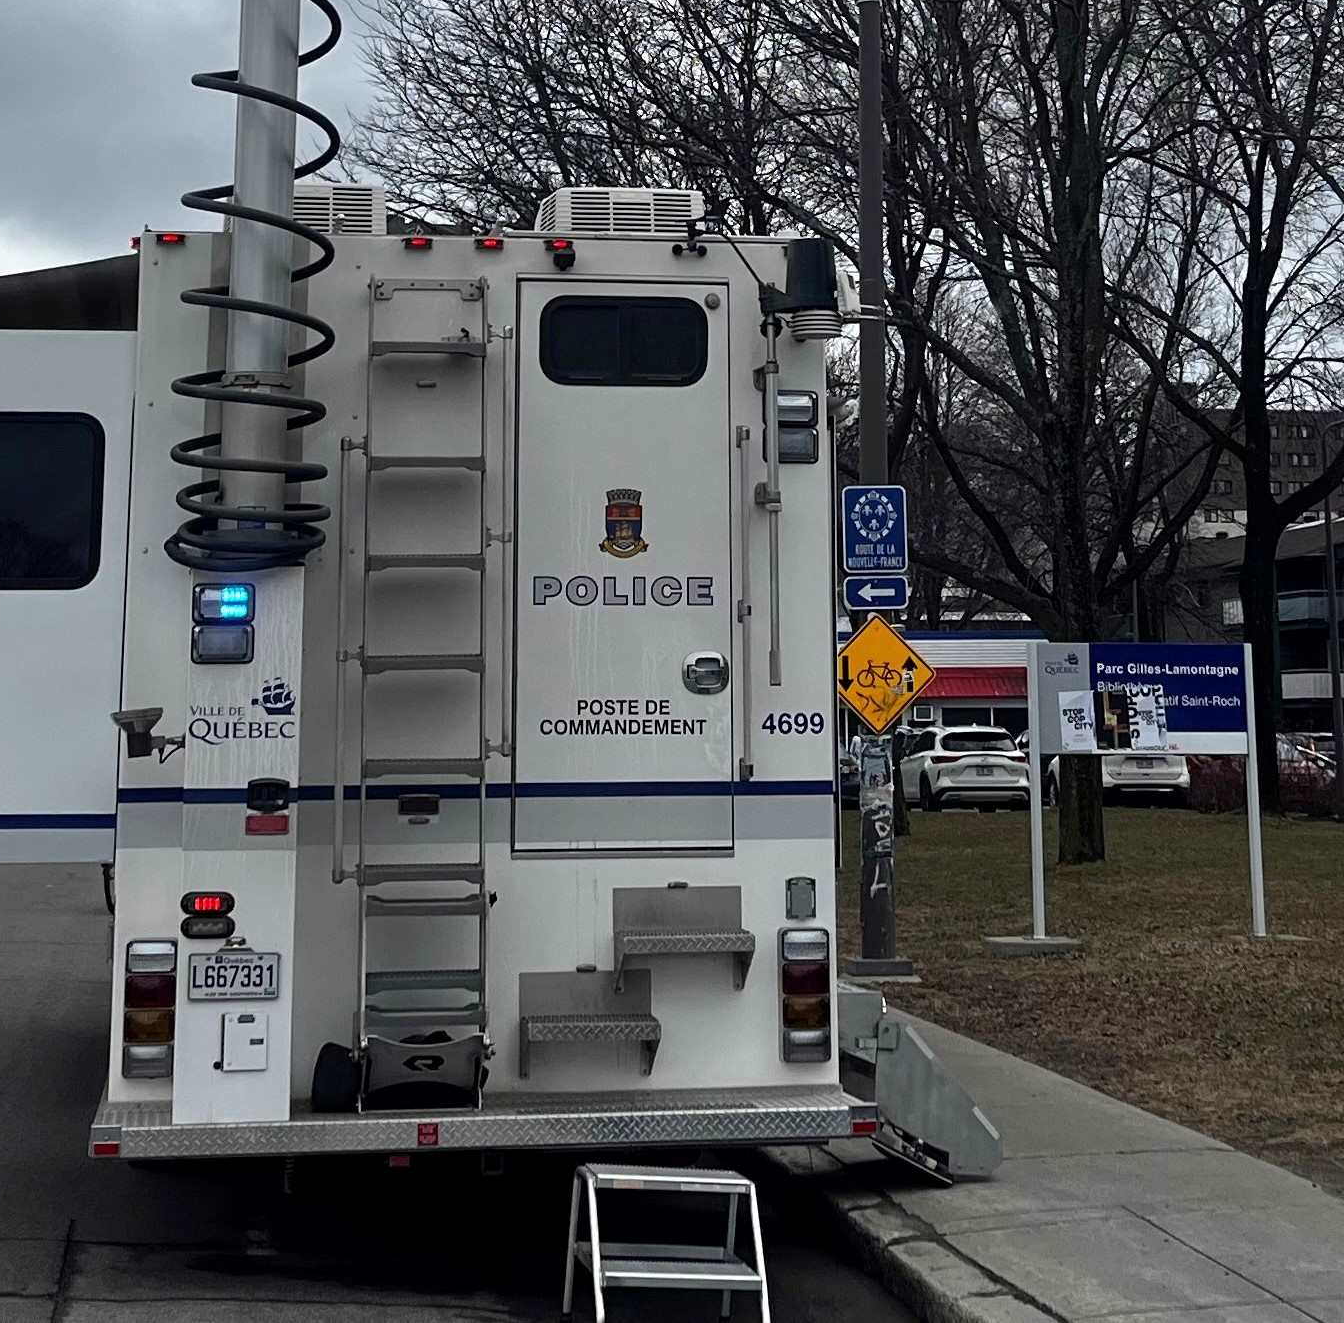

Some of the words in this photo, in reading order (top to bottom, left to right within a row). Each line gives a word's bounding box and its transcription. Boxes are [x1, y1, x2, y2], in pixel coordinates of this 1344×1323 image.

[876, 543, 885, 554] DE
[886, 543, 896, 554] LA
[532, 575, 714, 607] POLICE
[1096, 663, 1124, 675] Parc
[1127, 663, 1239, 677] Gilles-Lamontagne
[577, 699, 639, 716] POSTE
[645, 699, 670, 715] DE
[1181, 696, 1241, 707] Saint-Roch
[190, 706, 224, 717] VILLE
[229, 706, 246, 716] DE
[1062, 708, 1085, 717] STOP
[761, 712, 825, 735] 4699
[1067, 716, 1086, 724] COP
[1074, 722, 1094, 730] CITY
[189, 717, 296, 745] QUÉBEC
[540, 719, 707, 736] COMMANDEMENT
[192, 964, 274, 989] L667331
